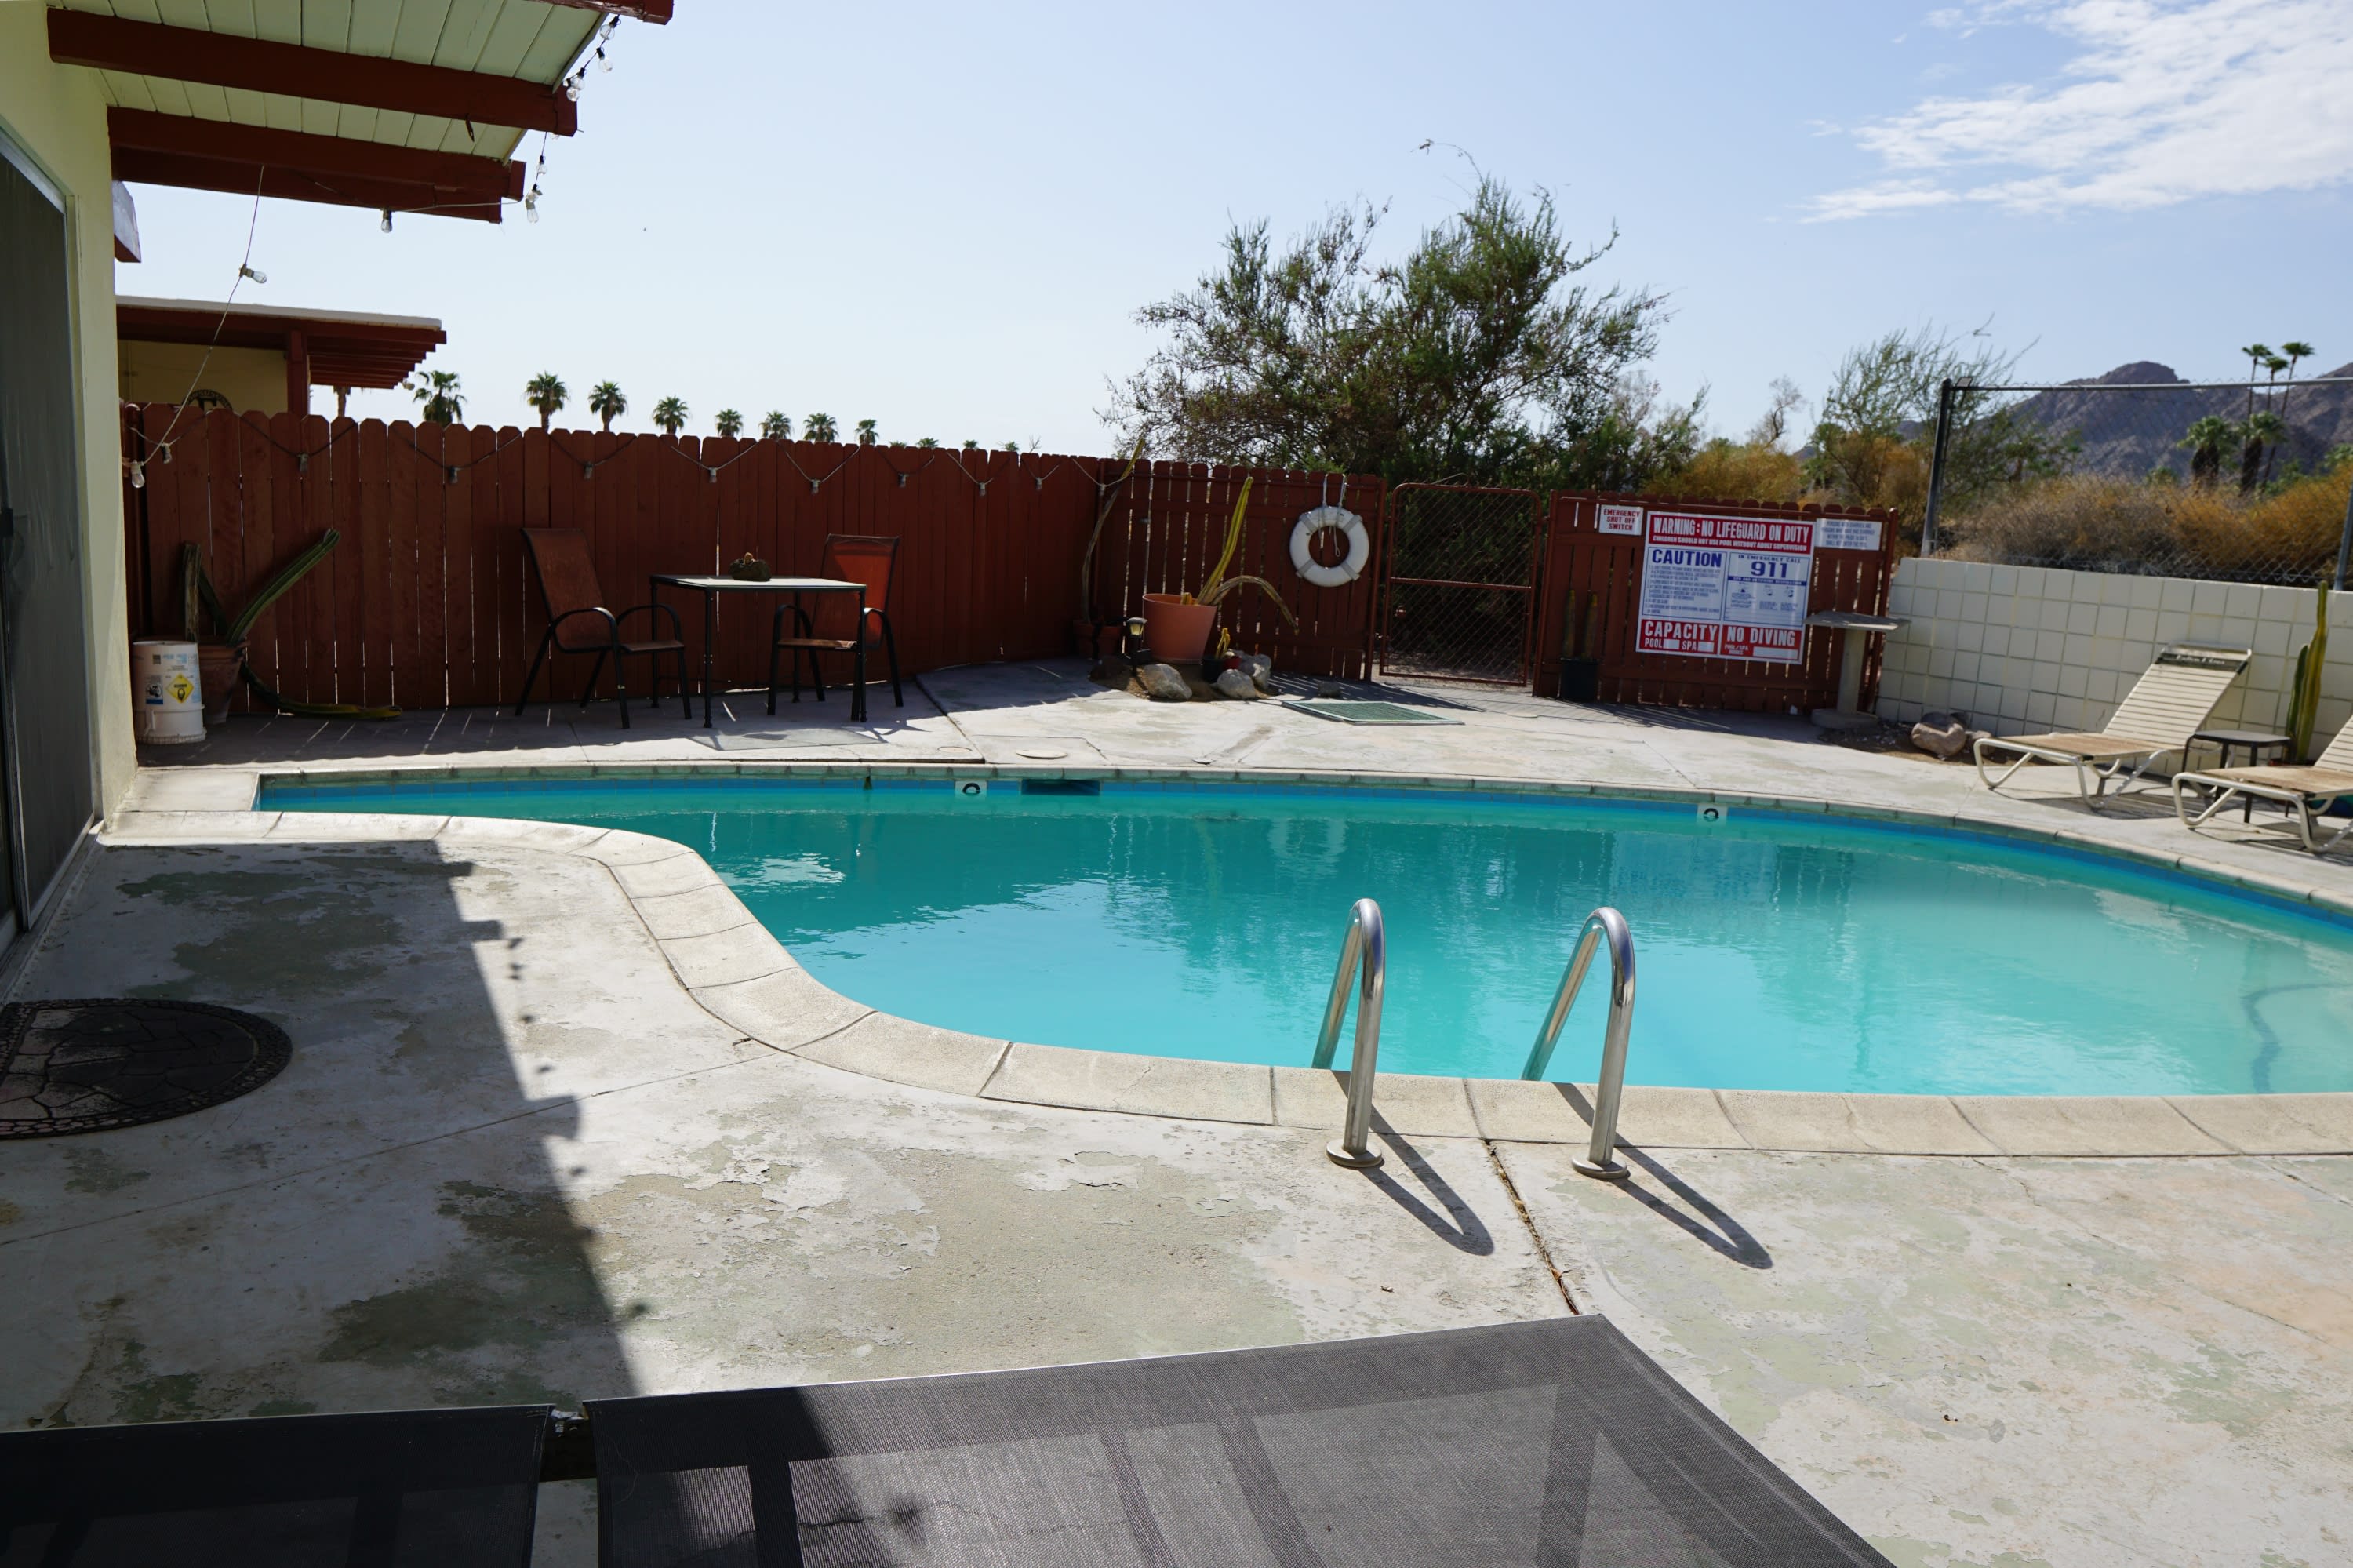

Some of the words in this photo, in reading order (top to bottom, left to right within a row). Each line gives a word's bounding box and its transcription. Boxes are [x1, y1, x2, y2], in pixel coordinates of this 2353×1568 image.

[1701, 520, 1714, 537] NO
[1716, 521, 1766, 540] LIFEGUARD
[1769, 524, 1782, 541] ON
[1784, 526, 1809, 543] DUTY
[1652, 549, 1722, 568] CAUTION
[1751, 561, 1787, 577] 911
[1645, 620, 1718, 641] CAPACITY
[1727, 626, 1744, 642] NO
[1750, 628, 1795, 647] DIVING
[1644, 638, 1663, 649] POOL
[1682, 641, 1697, 650] SPA
